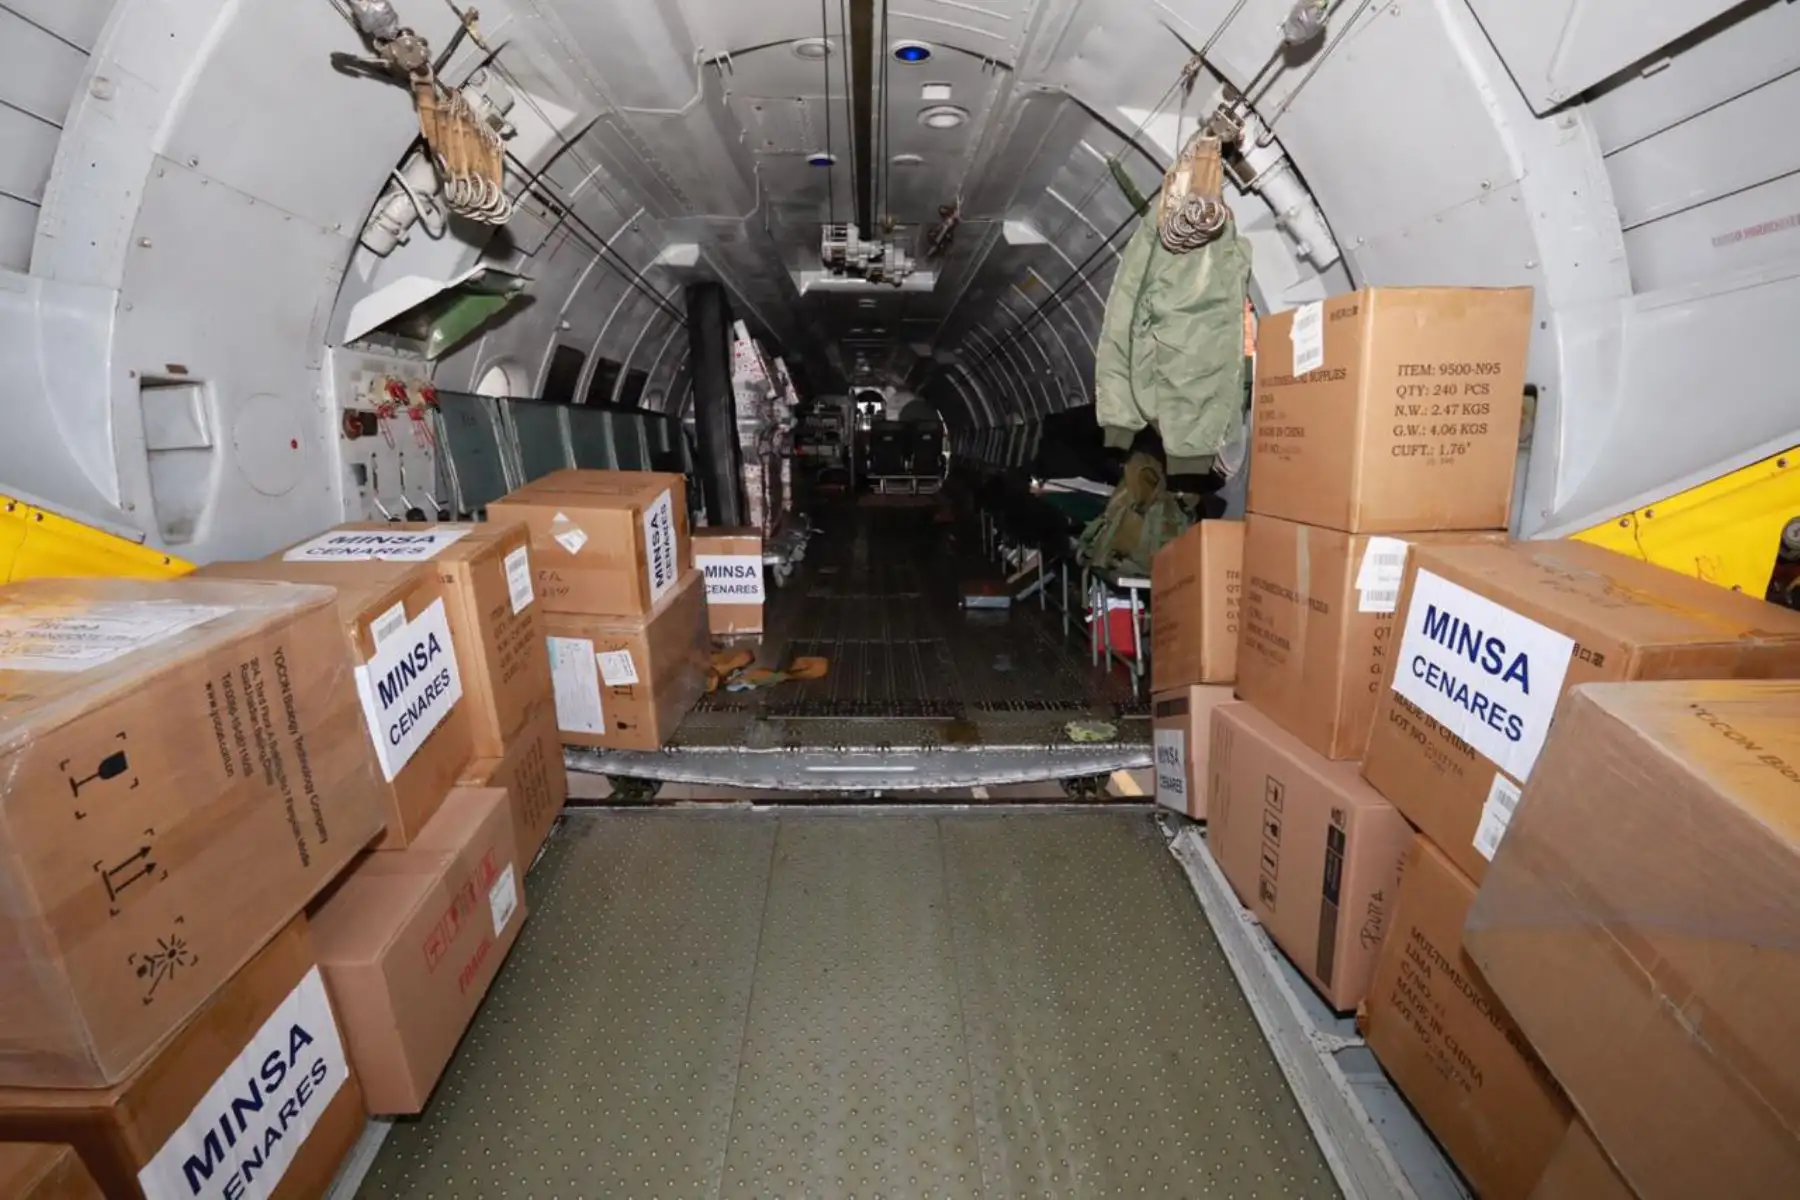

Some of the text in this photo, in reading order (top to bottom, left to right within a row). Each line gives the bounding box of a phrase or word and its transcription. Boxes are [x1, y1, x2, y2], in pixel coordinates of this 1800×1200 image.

[1398, 362, 1501, 376] ITEM: 9500-N95
[1396, 383, 1490, 399] QTY: 240 PCS
[1395, 403, 1490, 417] N.W.: 2.47 KGS
[1393, 422, 1488, 437] G.W.: 4.06 KGS
[1391, 444, 1435, 457] CUFT.:
[306, 547, 426, 555] CENARES
[328, 535, 435, 544] MINSA
[650, 512, 664, 589] MINSA
[661, 503, 673, 580] CENARES
[704, 565, 757, 578] MINSA
[704, 584, 758, 594] CENARES
[1422, 604, 1530, 695] MINSA
[273, 645, 291, 694] YOCON
[377, 631, 442, 711] MINSA
[389, 667, 451, 746] CENARES
[1412, 655, 1524, 742] CENARES
[1389, 708, 1410, 731] LOT
[1405, 943, 1431, 979] LIMA
[1411, 926, 1502, 1031] MULTIMEDICAL
[1390, 990, 1412, 1021] LOT
[1397, 976, 1430, 1020] MADE
[1428, 1015, 1443, 1036] IN
[1445, 1034, 1483, 1089] CHINA
[182, 1024, 314, 1196] MINSA
[222, 1057, 327, 1200] ENARES
